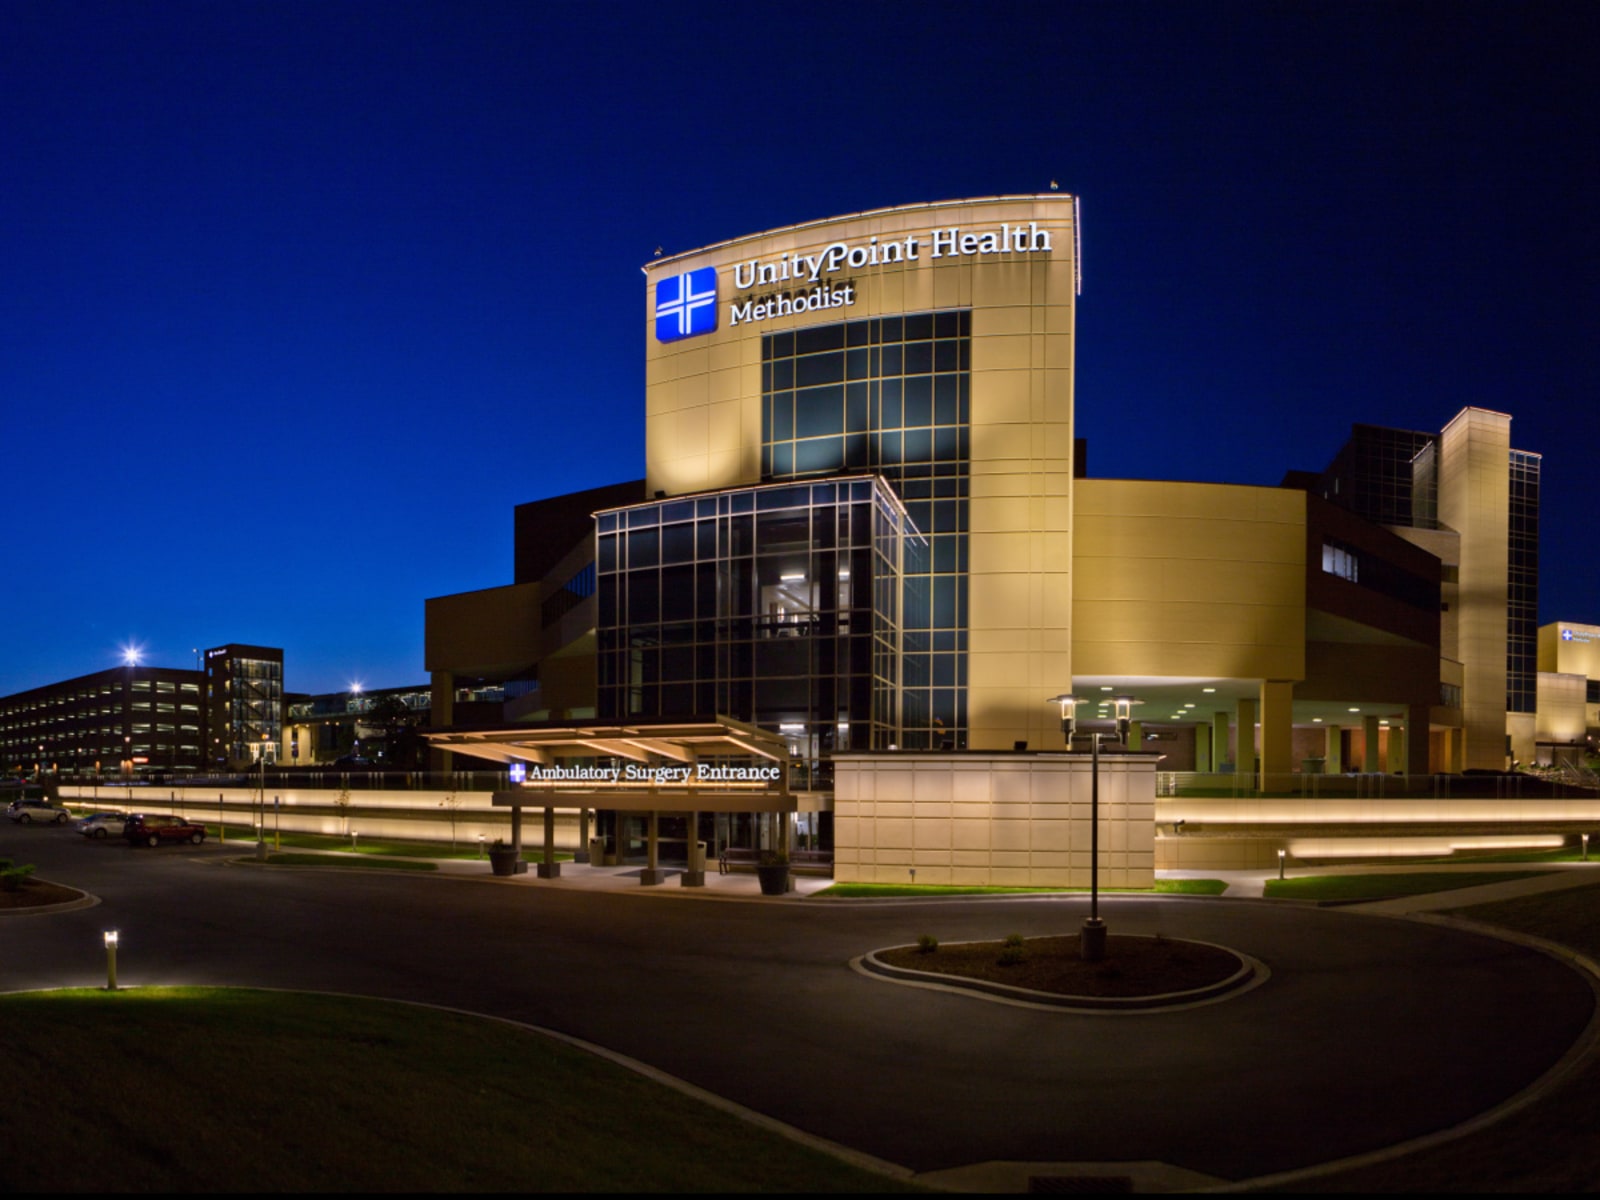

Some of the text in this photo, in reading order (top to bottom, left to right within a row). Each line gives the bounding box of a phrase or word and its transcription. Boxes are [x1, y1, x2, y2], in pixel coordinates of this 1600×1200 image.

[733, 222, 1052, 289] UnityPoint Health
[729, 285, 855, 326] Methodist
[531, 763, 780, 783] Ambulatory Surgery Entrance
